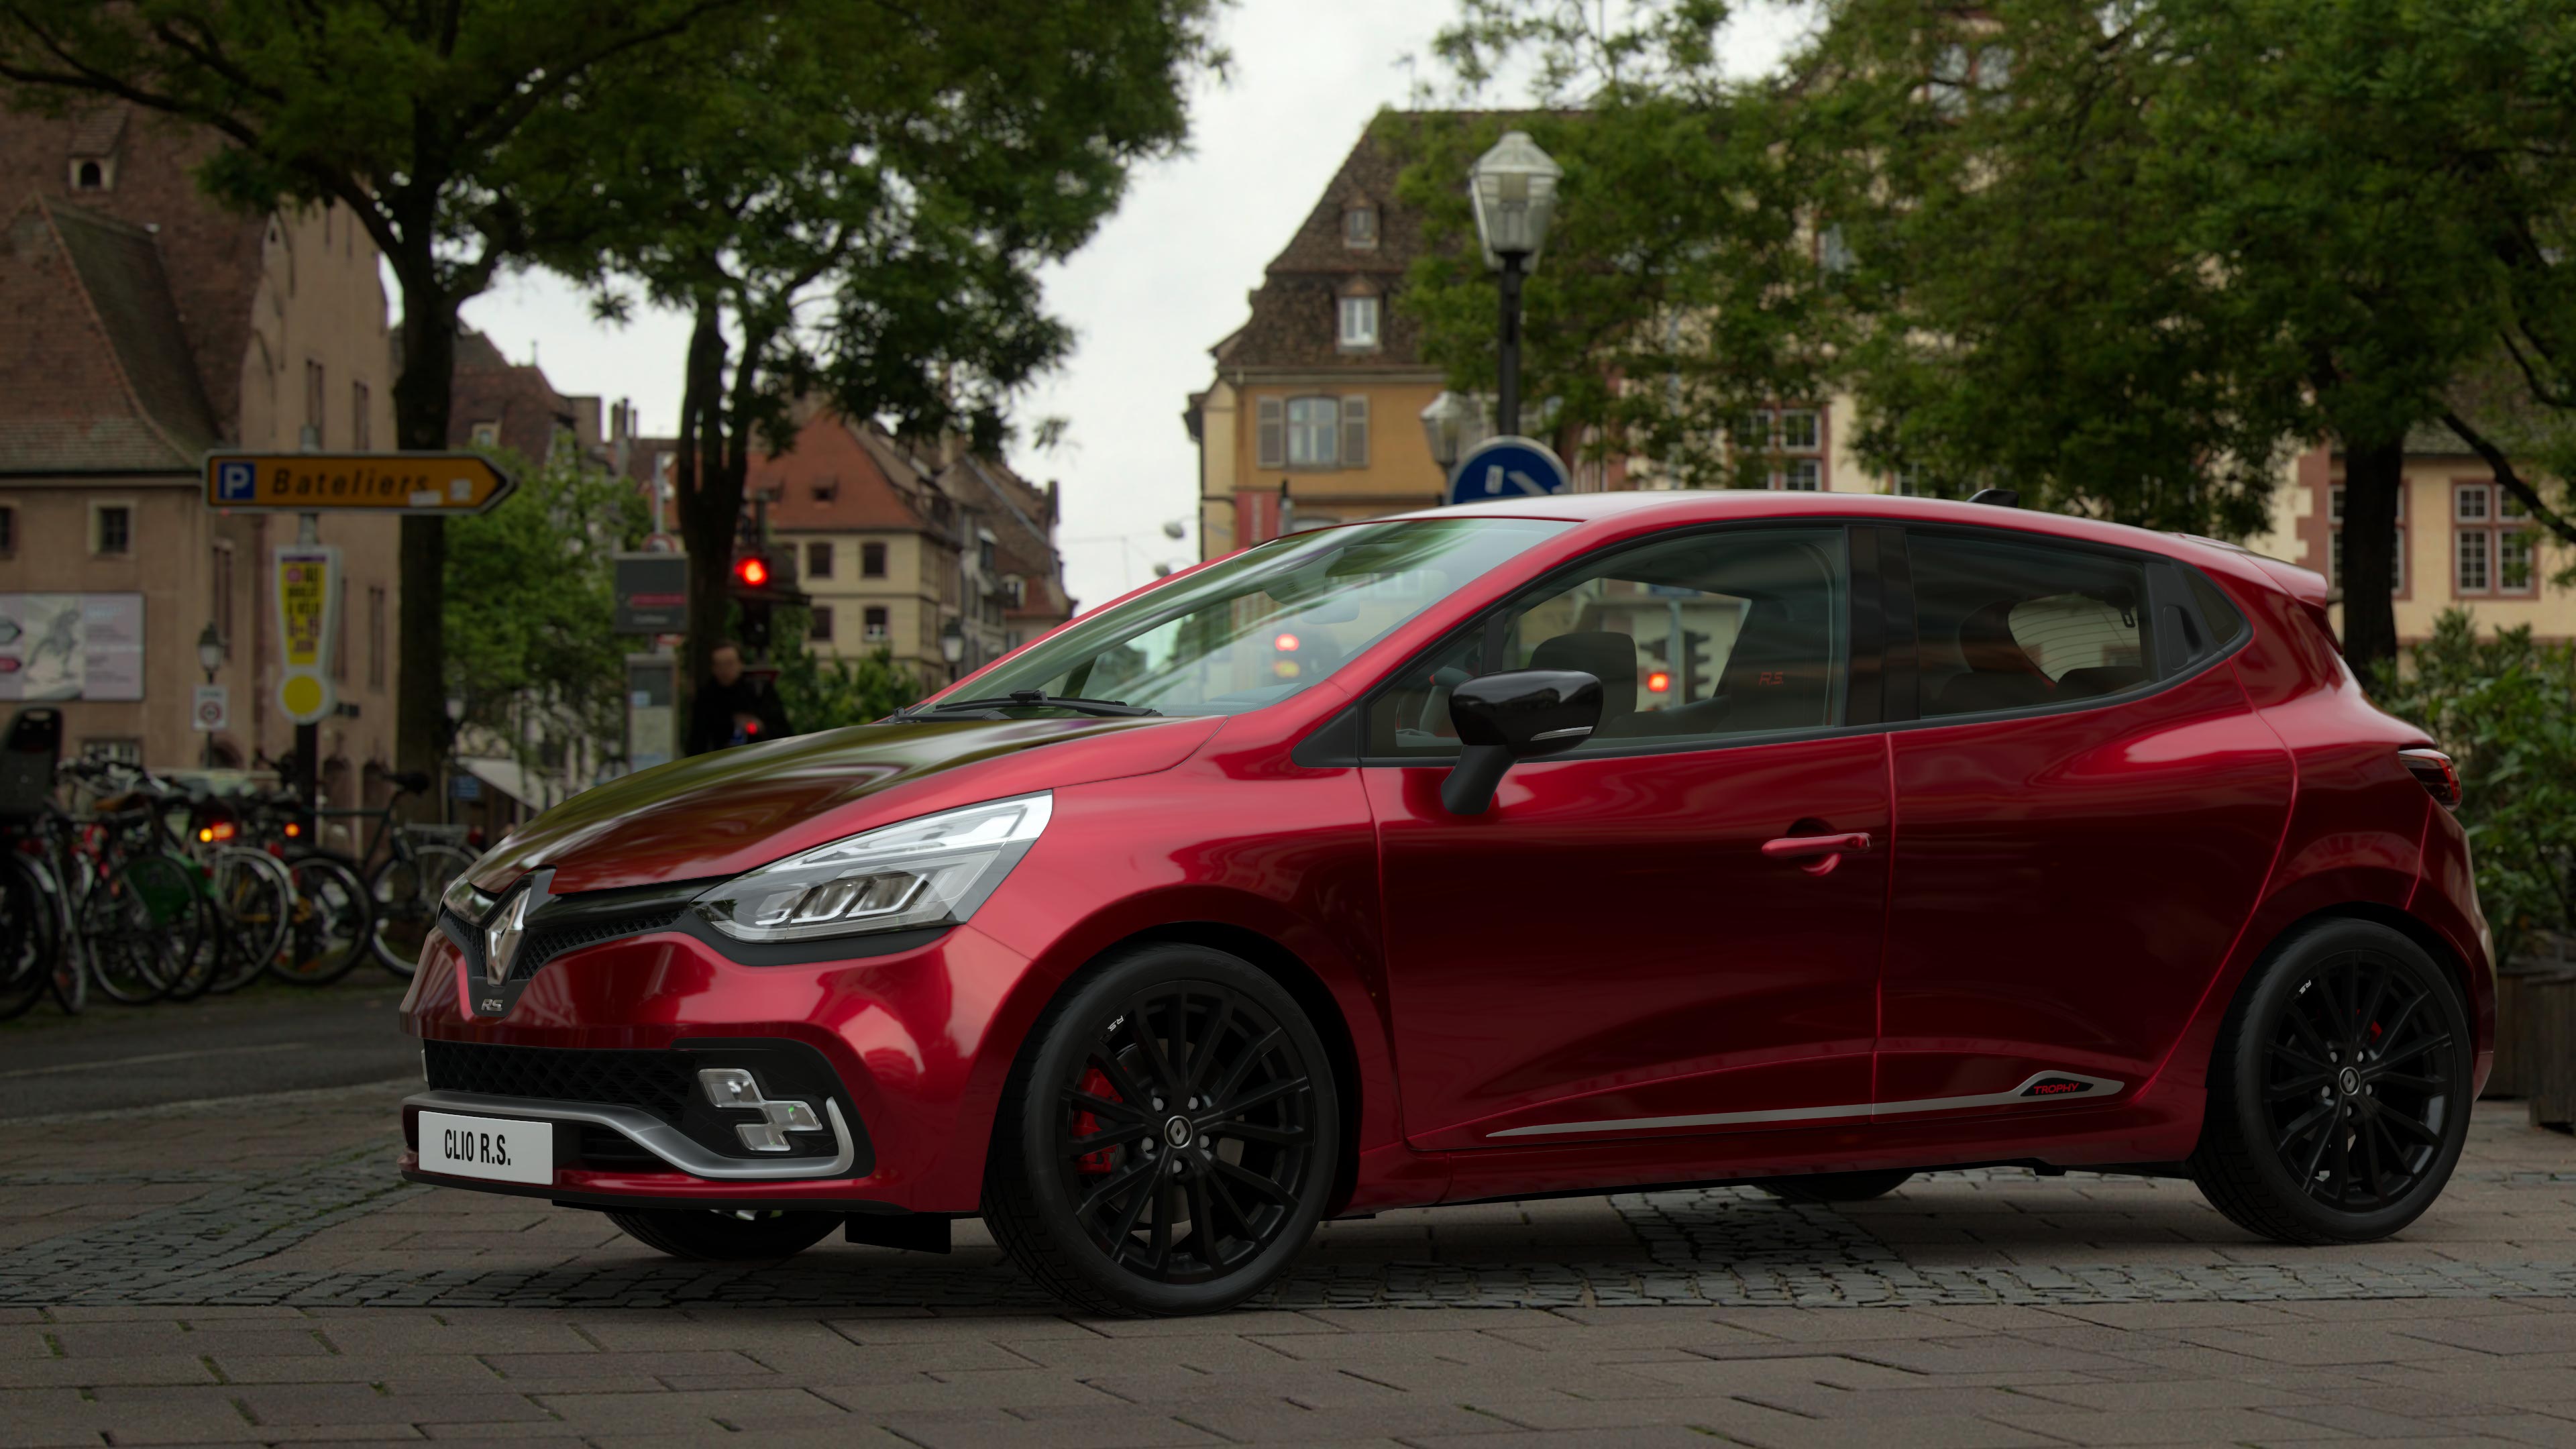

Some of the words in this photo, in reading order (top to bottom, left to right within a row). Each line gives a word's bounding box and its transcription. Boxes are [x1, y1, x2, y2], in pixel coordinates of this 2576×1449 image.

[224, 465, 251, 497] P
[272, 467, 430, 495] Bateliers
[1107, 1015, 1124, 1032] R.S.
[2033, 1082, 2080, 1095] TROPHY
[445, 1129, 474, 1161] CLIO
[480, 1133, 511, 1166] R.S.
